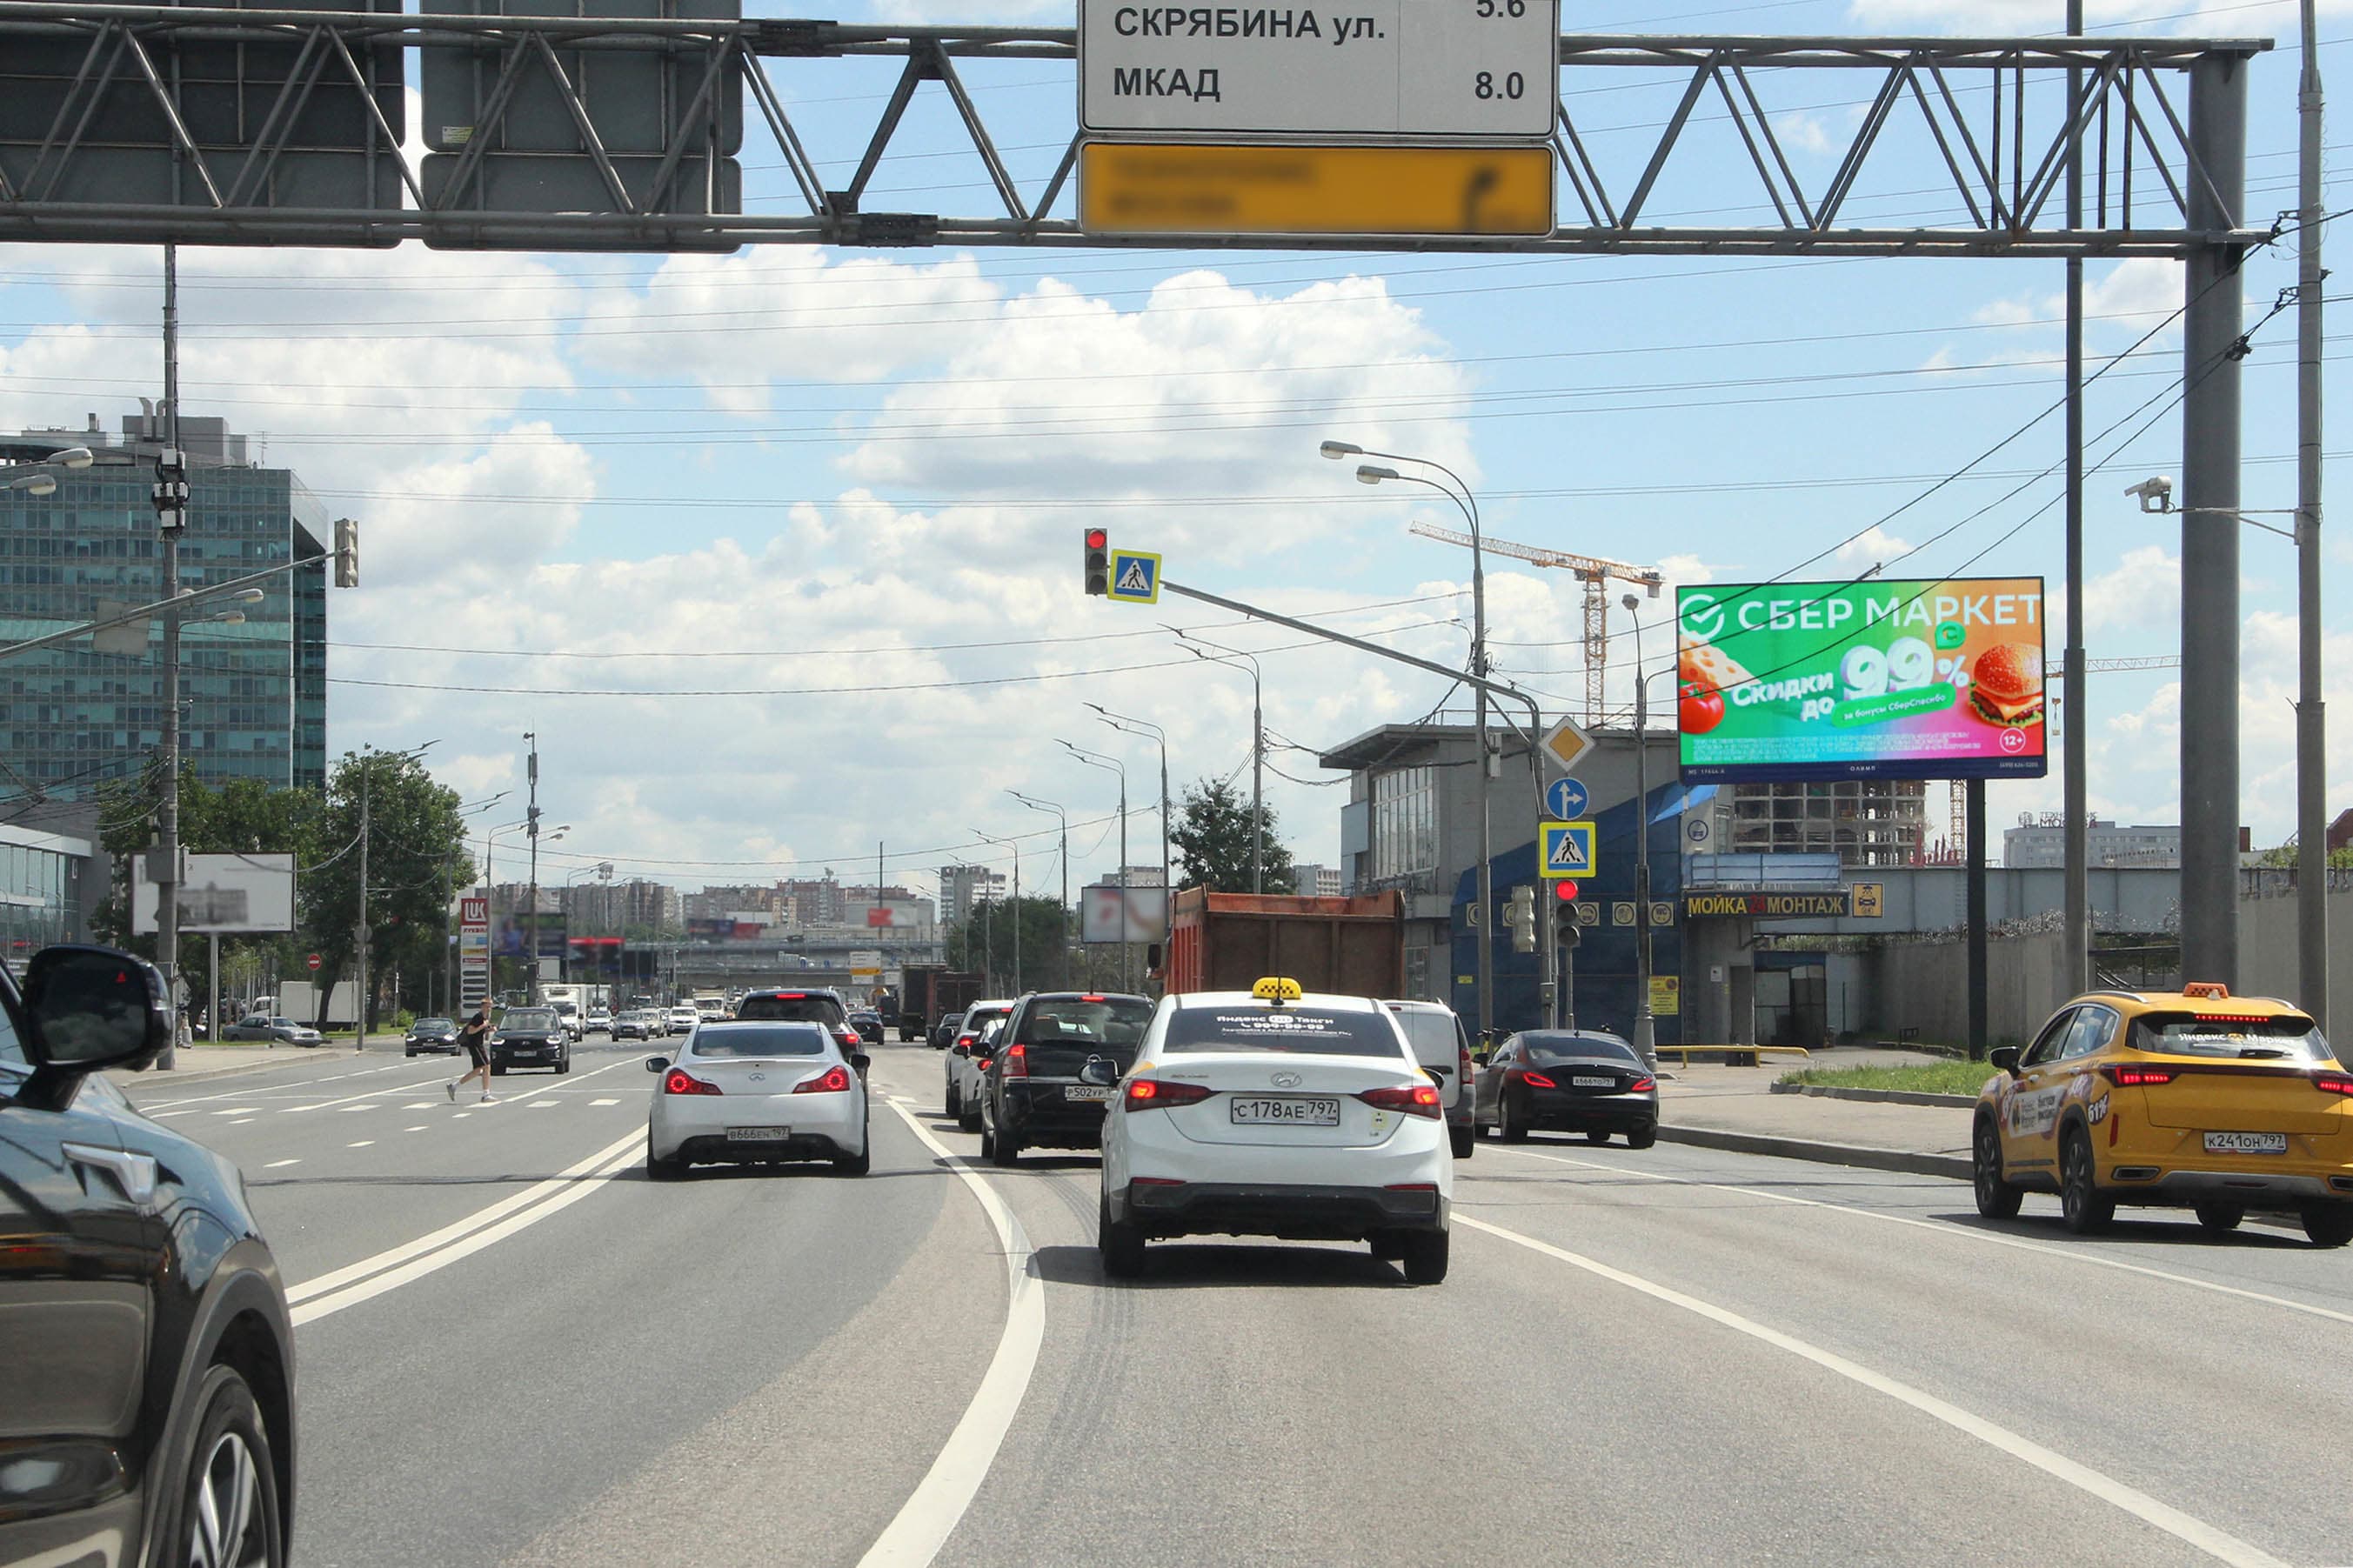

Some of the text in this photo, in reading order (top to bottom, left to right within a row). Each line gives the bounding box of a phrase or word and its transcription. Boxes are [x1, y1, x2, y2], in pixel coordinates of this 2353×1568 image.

[1476, 0, 1525, 17] 5.6
[1113, 7, 1385, 44] СКРЯБИНА ул.
[1113, 68, 1220, 102] МКАД
[1474, 71, 1525, 100] 8.0
[1738, 593, 2041, 631] СБЕР МАРКЕТ
[1731, 672, 1835, 706] Скидки
[1801, 697, 1835, 722] до
[1843, 692, 1947, 720] за бонусы СберСпасибо
[2003, 735, 2023, 746] 12+
[1688, 894, 1748, 914] МОЙКА
[1767, 896, 1843, 914] МОНТАЖ
[1294, 1016, 1334, 1024] Такси
[2177, 1033, 2228, 1042] Яндекс
[1237, 1101, 1334, 1118] С178АЕ 797
[2088, 1094, 2108, 1123] 61%
[2208, 1134, 2283, 1148] К241ОН 797
